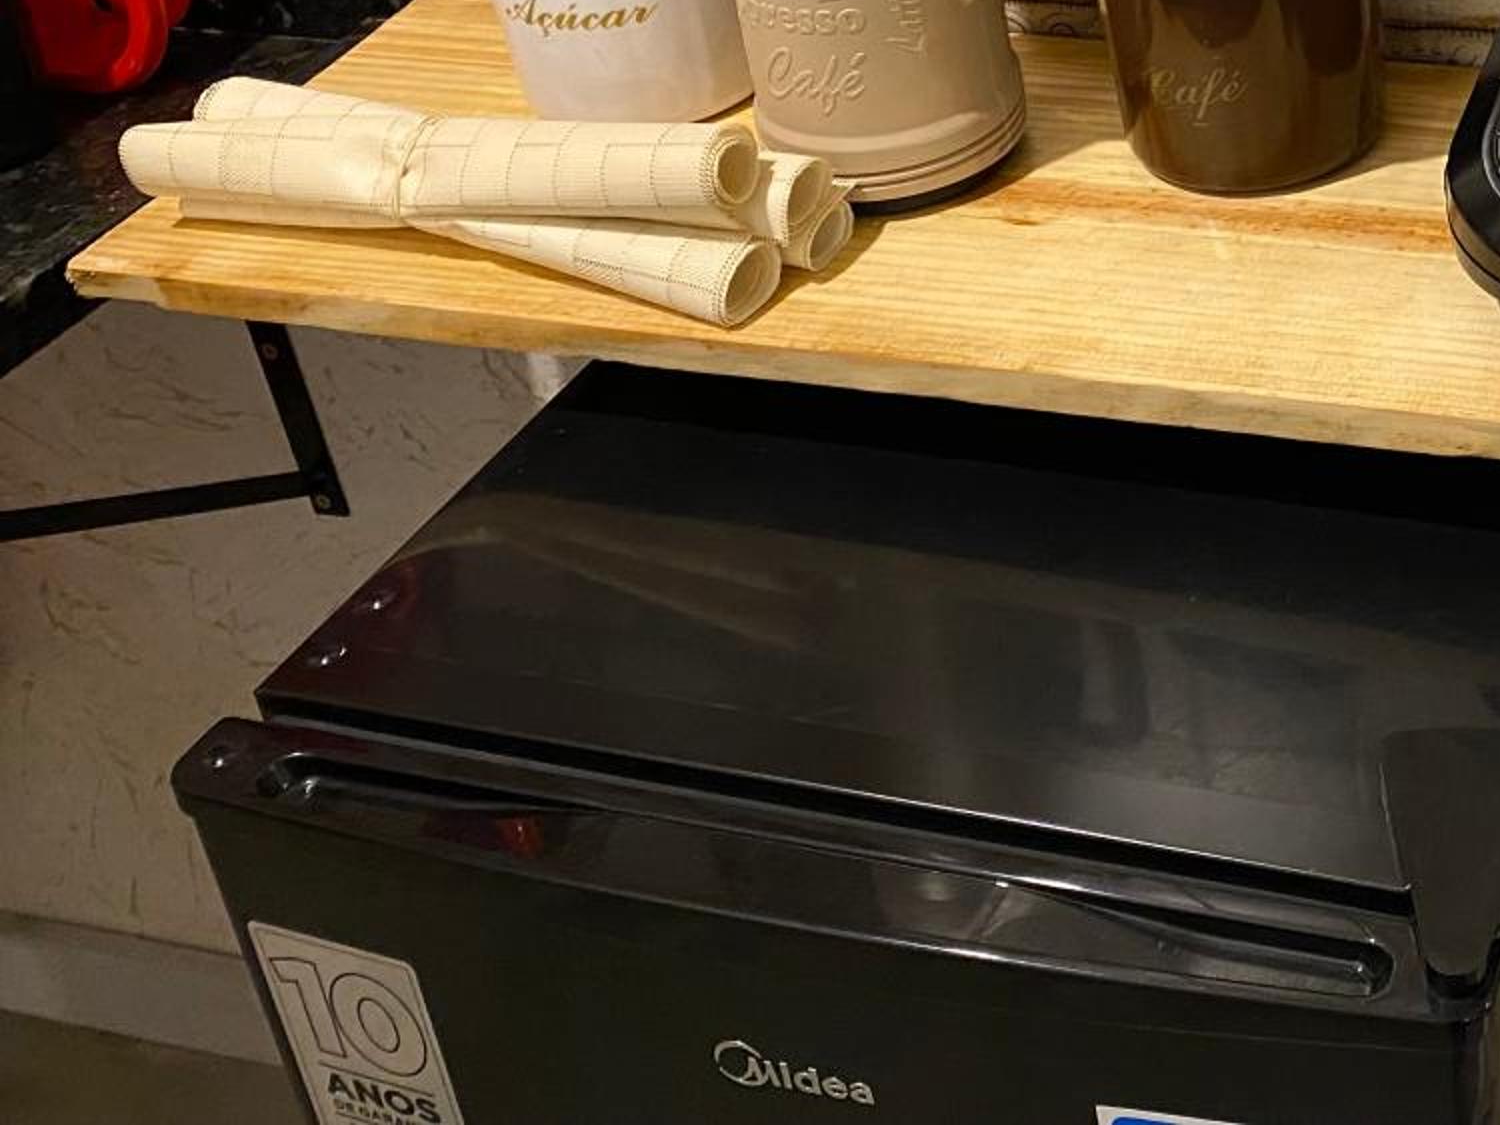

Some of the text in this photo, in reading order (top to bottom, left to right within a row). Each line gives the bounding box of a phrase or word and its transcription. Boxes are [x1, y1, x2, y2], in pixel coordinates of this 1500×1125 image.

[767, 46, 867, 117] Café
[1143, 66, 1248, 125] Café
[268, 957, 428, 1077] 10
[327, 1072, 442, 1124] ANOS
[713, 1039, 876, 1107] Midea
